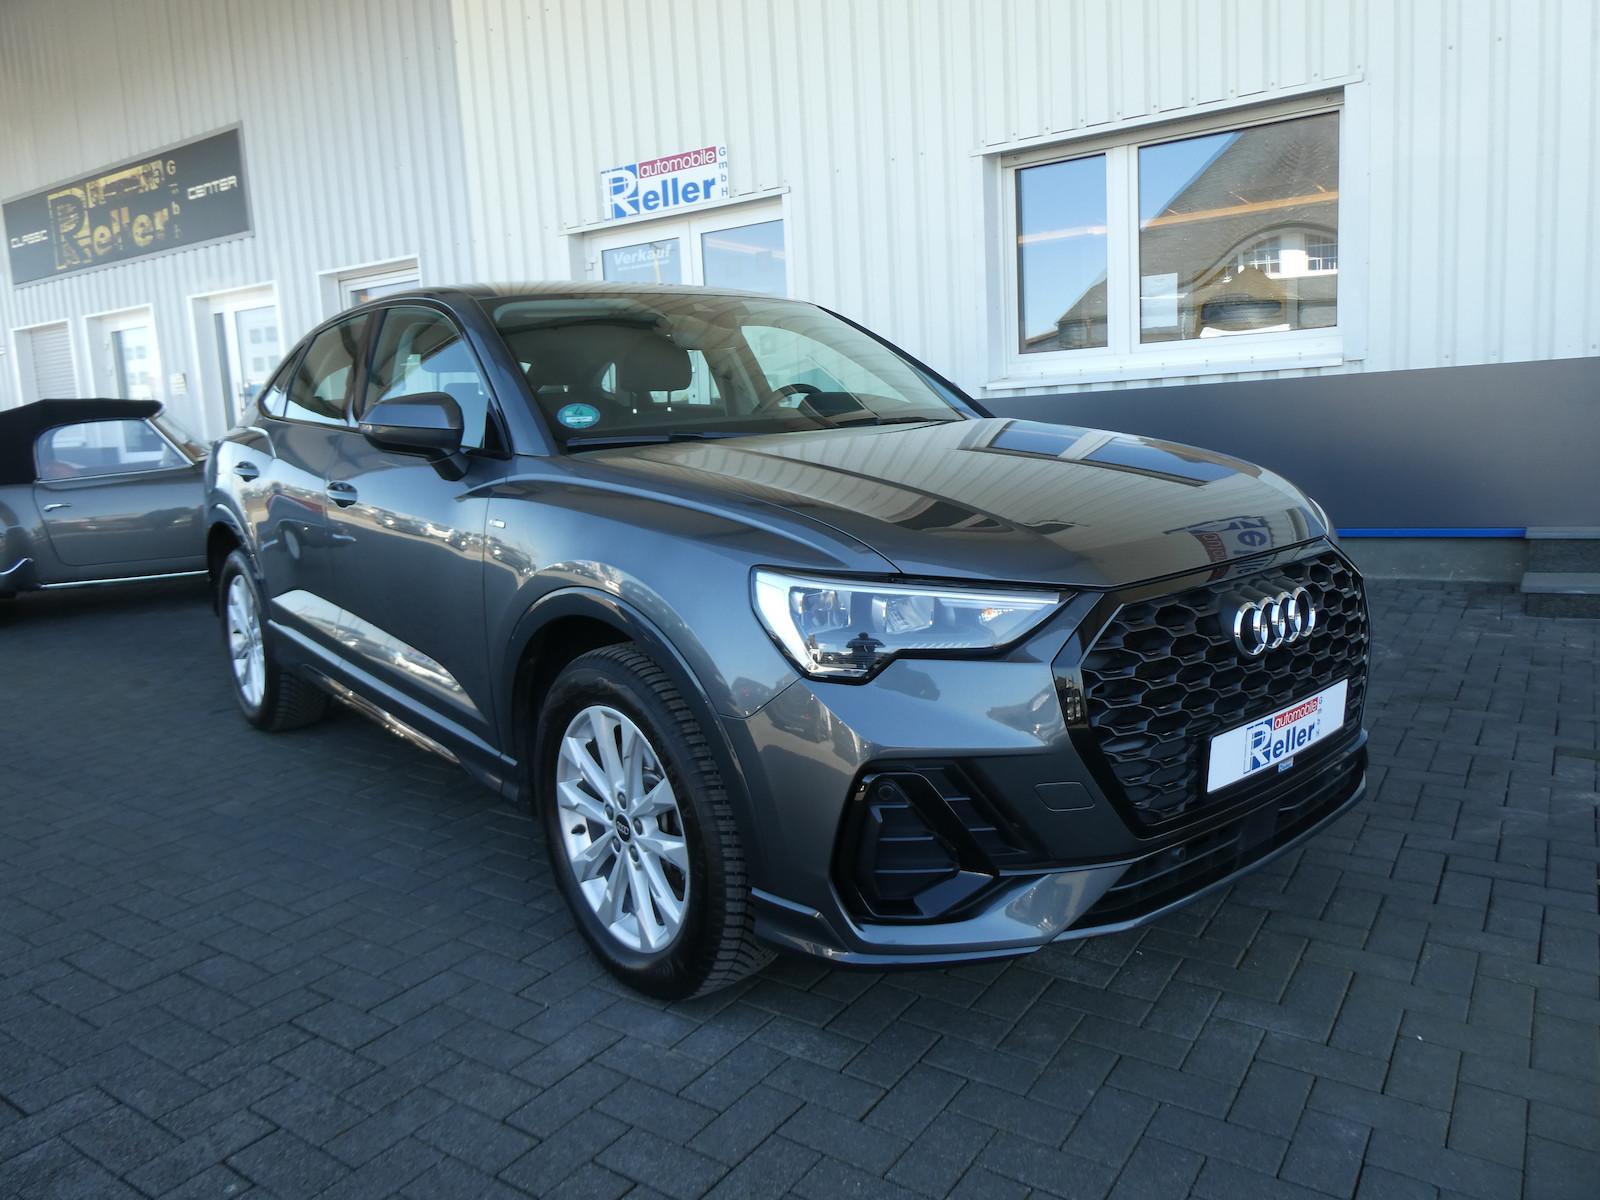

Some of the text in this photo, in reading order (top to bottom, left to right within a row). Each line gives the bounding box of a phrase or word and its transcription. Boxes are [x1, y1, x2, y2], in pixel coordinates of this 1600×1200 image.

[640, 149, 716, 177] automobile
[186, 175, 238, 200] CENTER
[600, 164, 717, 221] Reller
[614, 243, 672, 265] Verkauf
[1274, 699, 1318, 730] automobile
[1243, 718, 1316, 774] Reller
